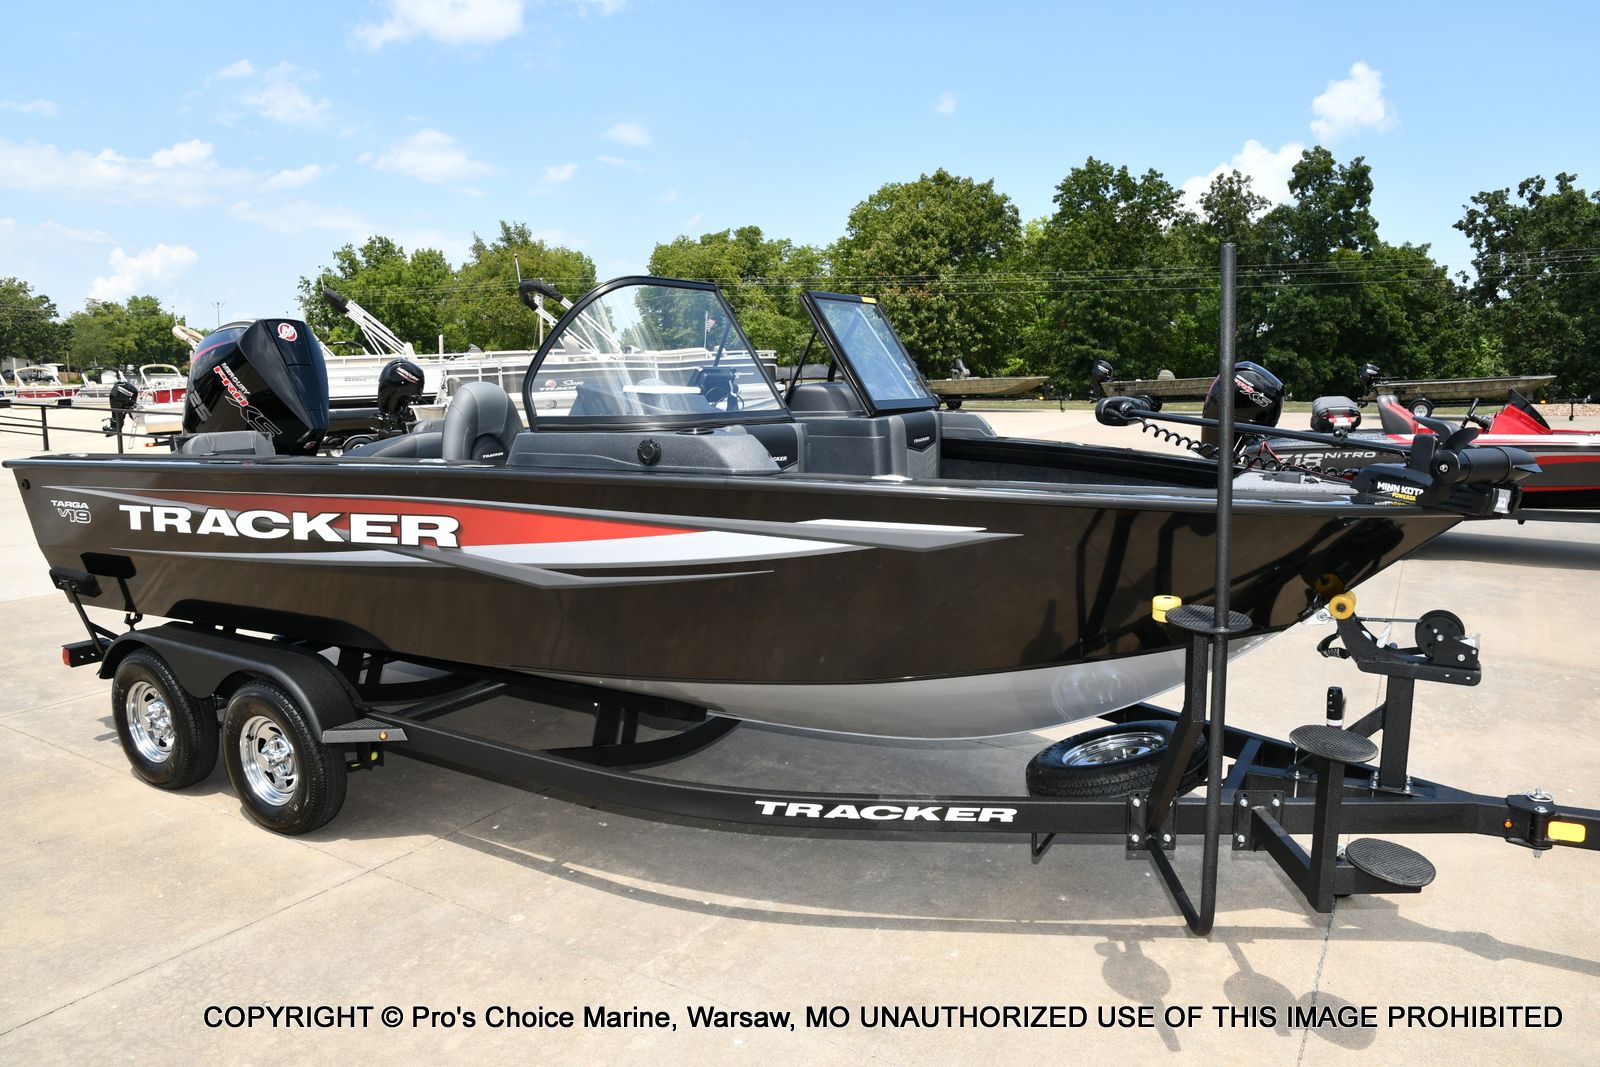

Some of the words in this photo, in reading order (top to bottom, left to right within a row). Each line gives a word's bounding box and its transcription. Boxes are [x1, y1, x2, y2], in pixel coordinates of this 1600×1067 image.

[213, 366, 249, 407] PRO
[221, 362, 250, 394] MERCURY
[225, 396, 283, 437] XS
[1377, 481, 1401, 493] MINN
[50, 499, 89, 510] TARGA
[56, 507, 92, 524] V19
[118, 504, 461, 549] TRACKER
[754, 800, 1018, 823] TRACKER
